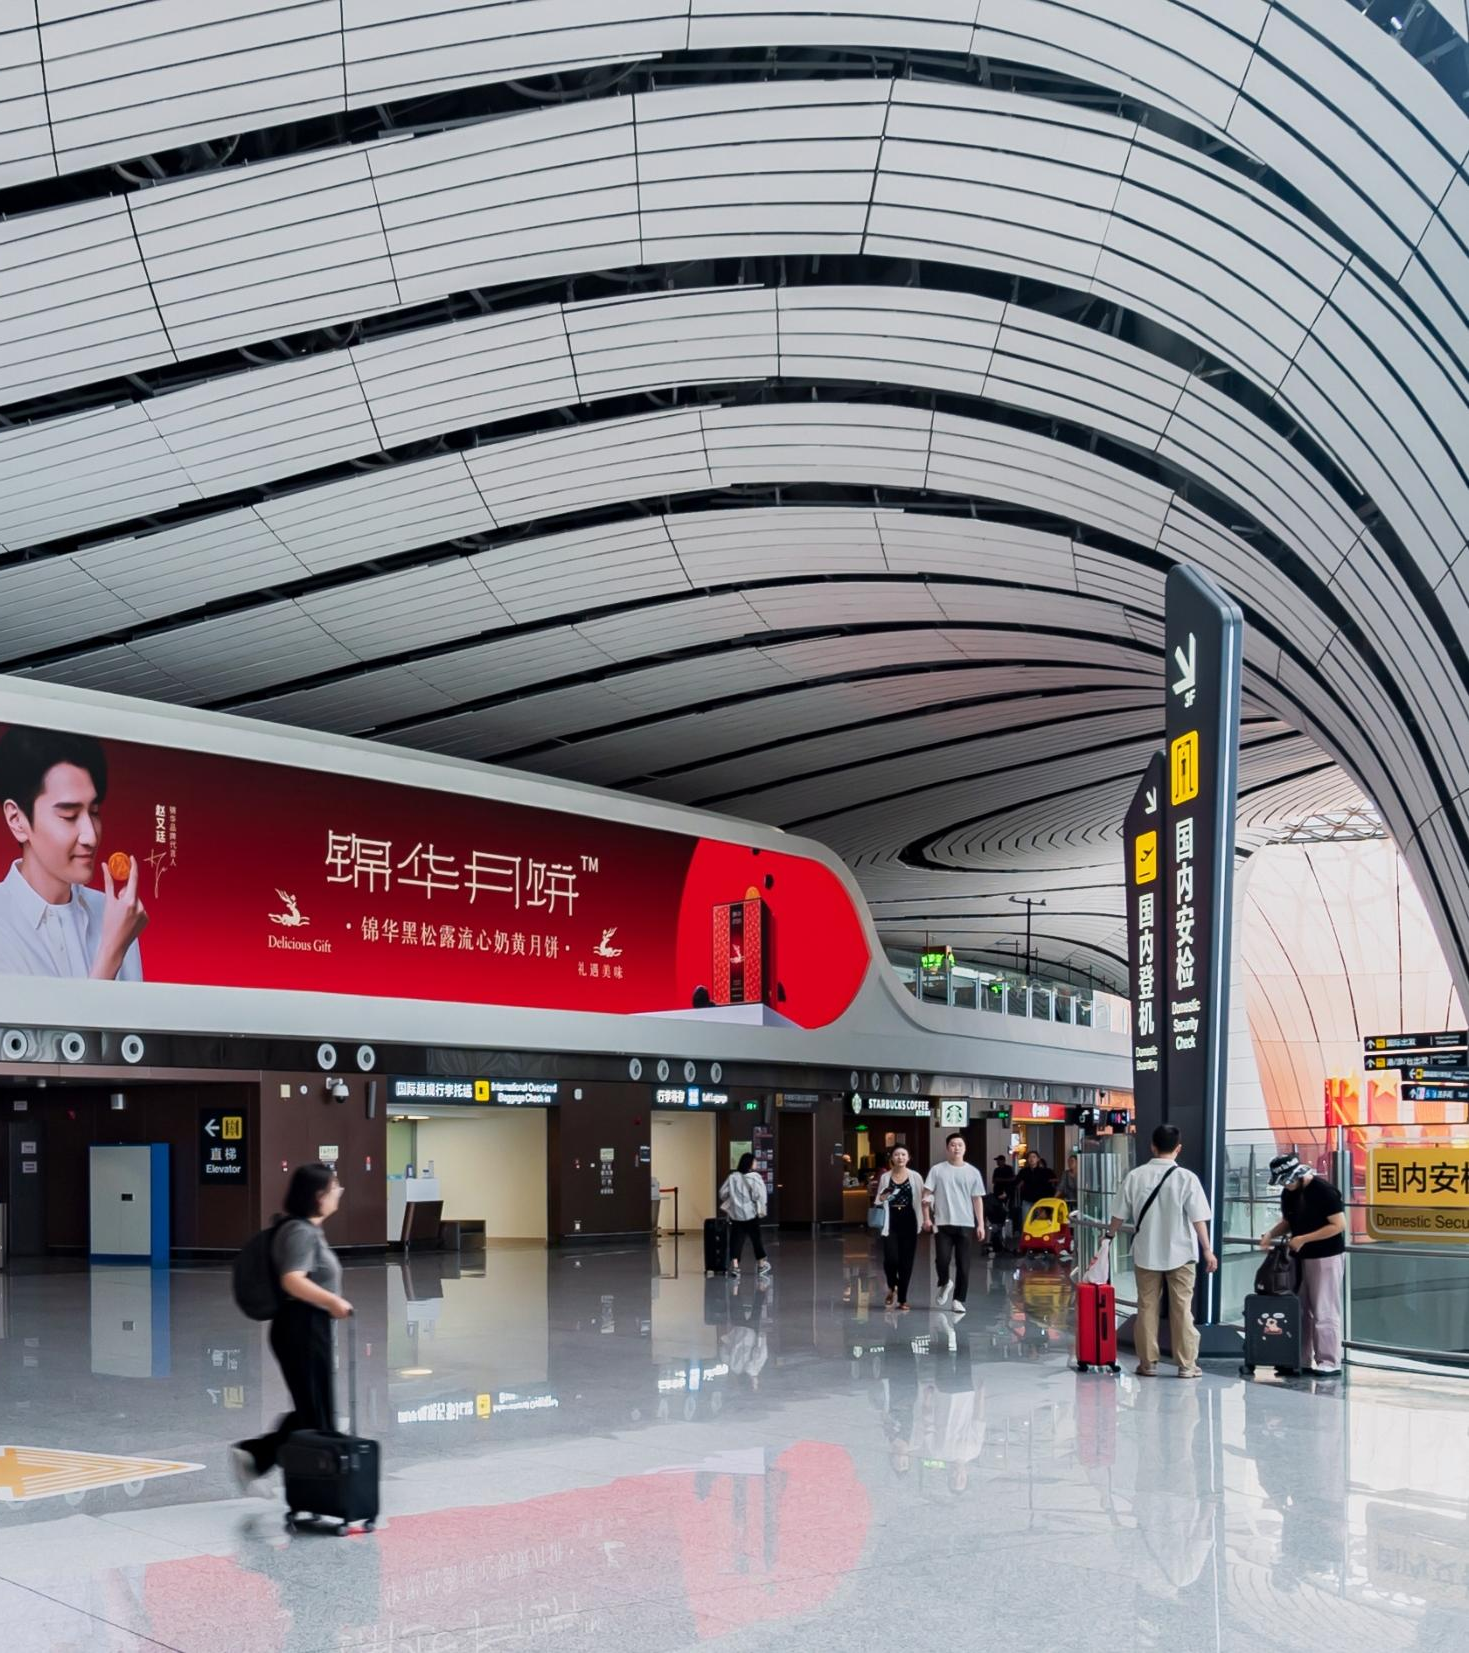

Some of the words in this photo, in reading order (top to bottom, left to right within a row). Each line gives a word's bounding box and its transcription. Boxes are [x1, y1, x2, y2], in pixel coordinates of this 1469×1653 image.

[155, 804, 166, 843] 赵又廷
[1175, 816, 1195, 991] 国内安检
[267, 934, 311, 952] Delicious
[312, 937, 332, 954] Gift
[577, 961, 624, 980] 礼遇美味
[1137, 892, 1155, 1036] 国内登机
[1171, 997, 1201, 1015] Domestic
[1173, 1016, 1199, 1033] Security
[1175, 1034, 1196, 1051] Check
[395, 1081, 473, 1098] 国际超规行李托运
[868, 1098, 906, 1111] STARBUCKS
[906, 1100, 929, 1111] COFFEE
[210, 1147, 237, 1161] 直梯
[205, 1164, 241, 1174] Elevator
[1377, 1161, 1469, 1194] 国内安
[1377, 1213, 1431, 1228] Domestic
